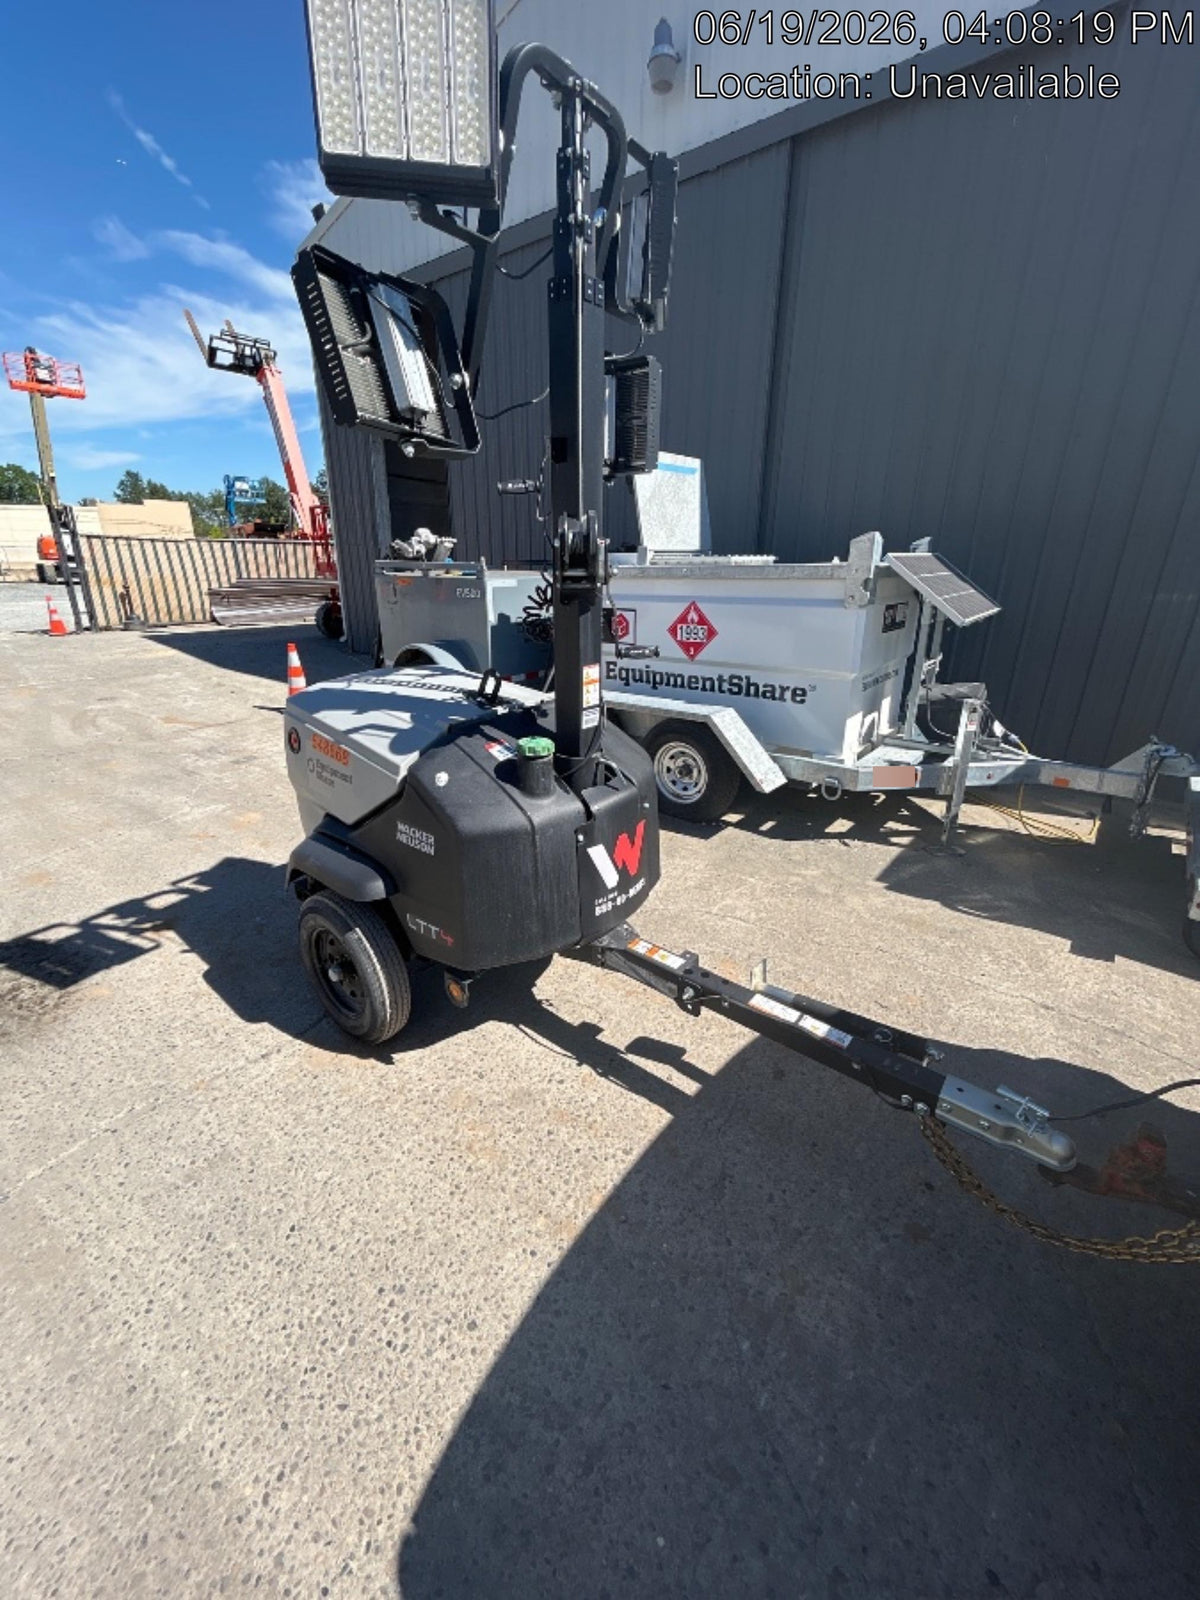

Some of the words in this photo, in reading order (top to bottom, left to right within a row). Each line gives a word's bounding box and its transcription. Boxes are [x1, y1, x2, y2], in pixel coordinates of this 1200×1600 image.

[678, 624, 708, 641] 1993
[604, 660, 808, 705] EquipmentShare
[395, 831, 435, 857] NEUSON
[396, 820, 435, 845] WACKER
